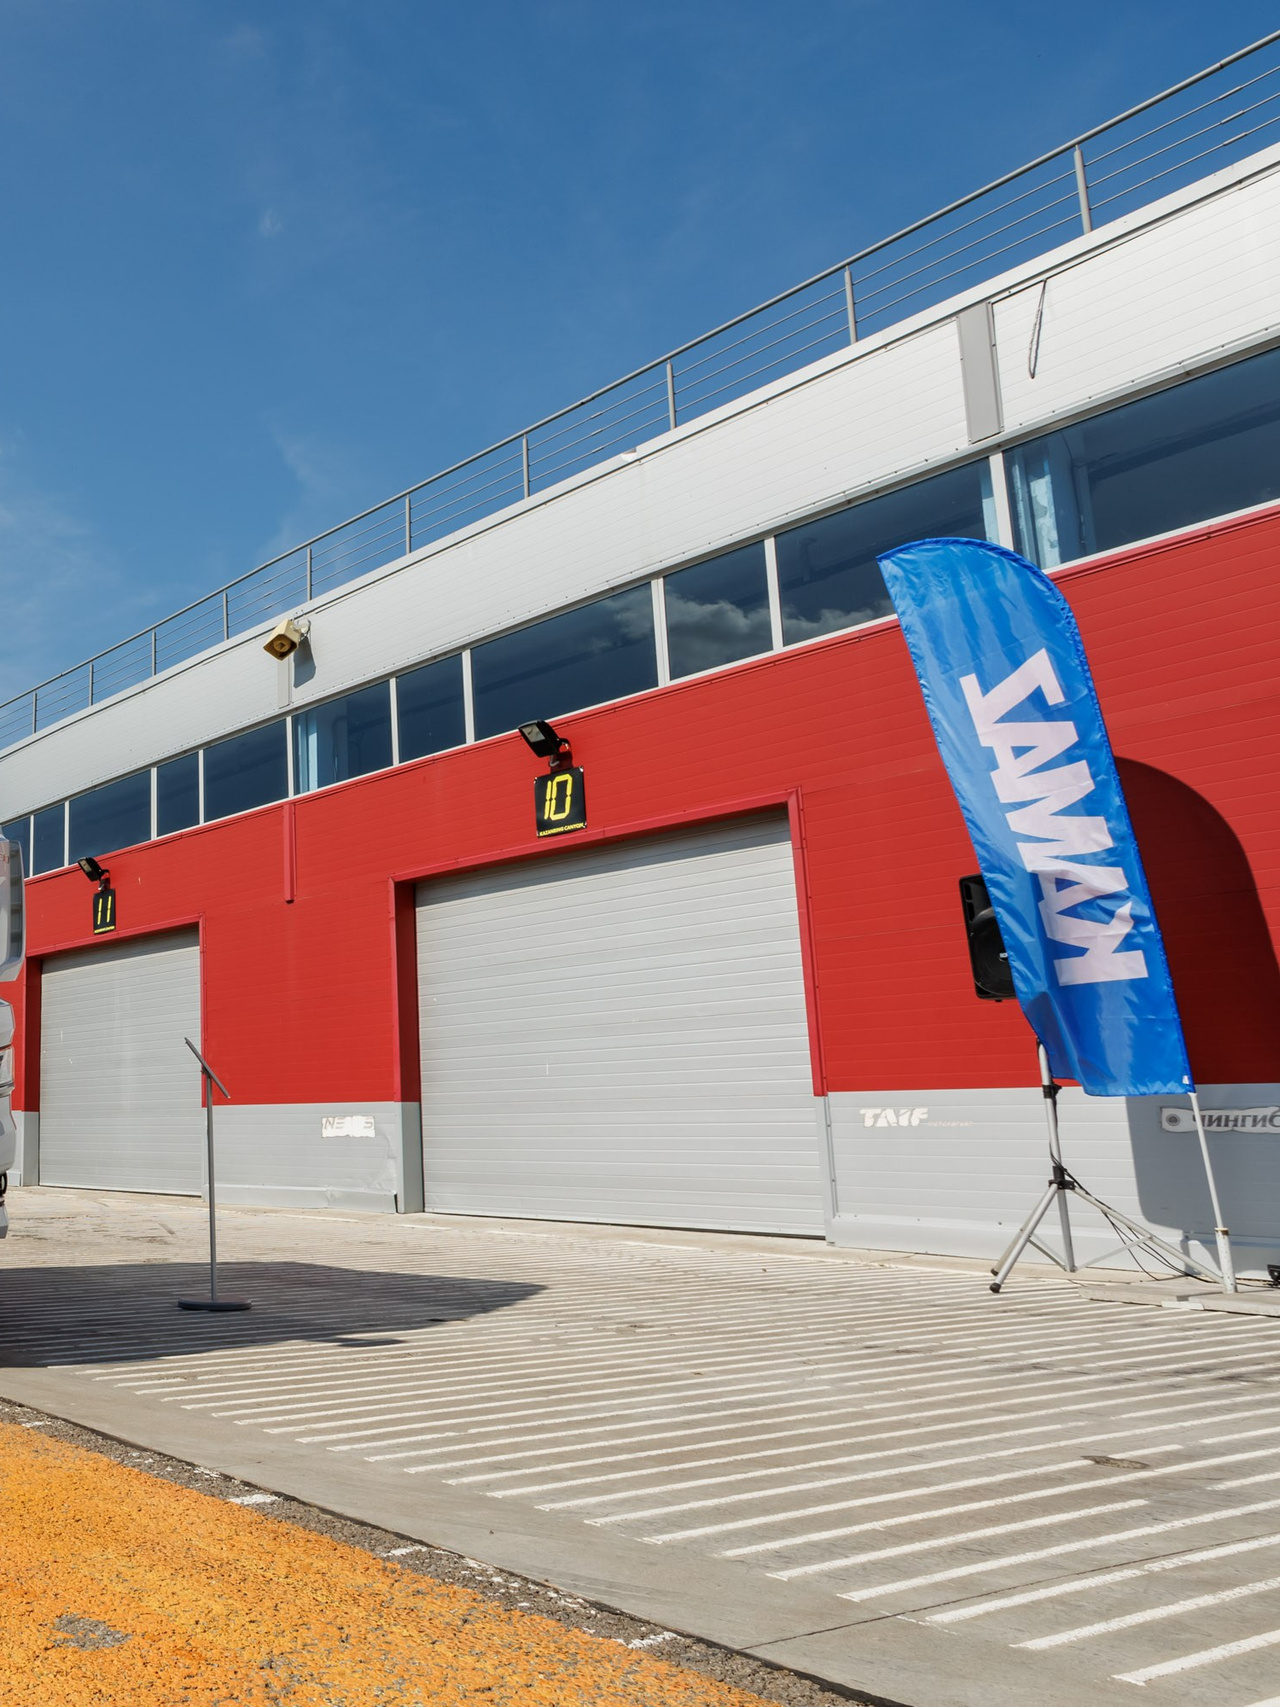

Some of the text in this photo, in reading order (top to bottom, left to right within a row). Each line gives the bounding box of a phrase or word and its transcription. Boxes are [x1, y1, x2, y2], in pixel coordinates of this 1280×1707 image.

[543, 773, 573, 821] 10
[97, 895, 112, 925] 11
[859, 1107, 929, 1128] TAIF
